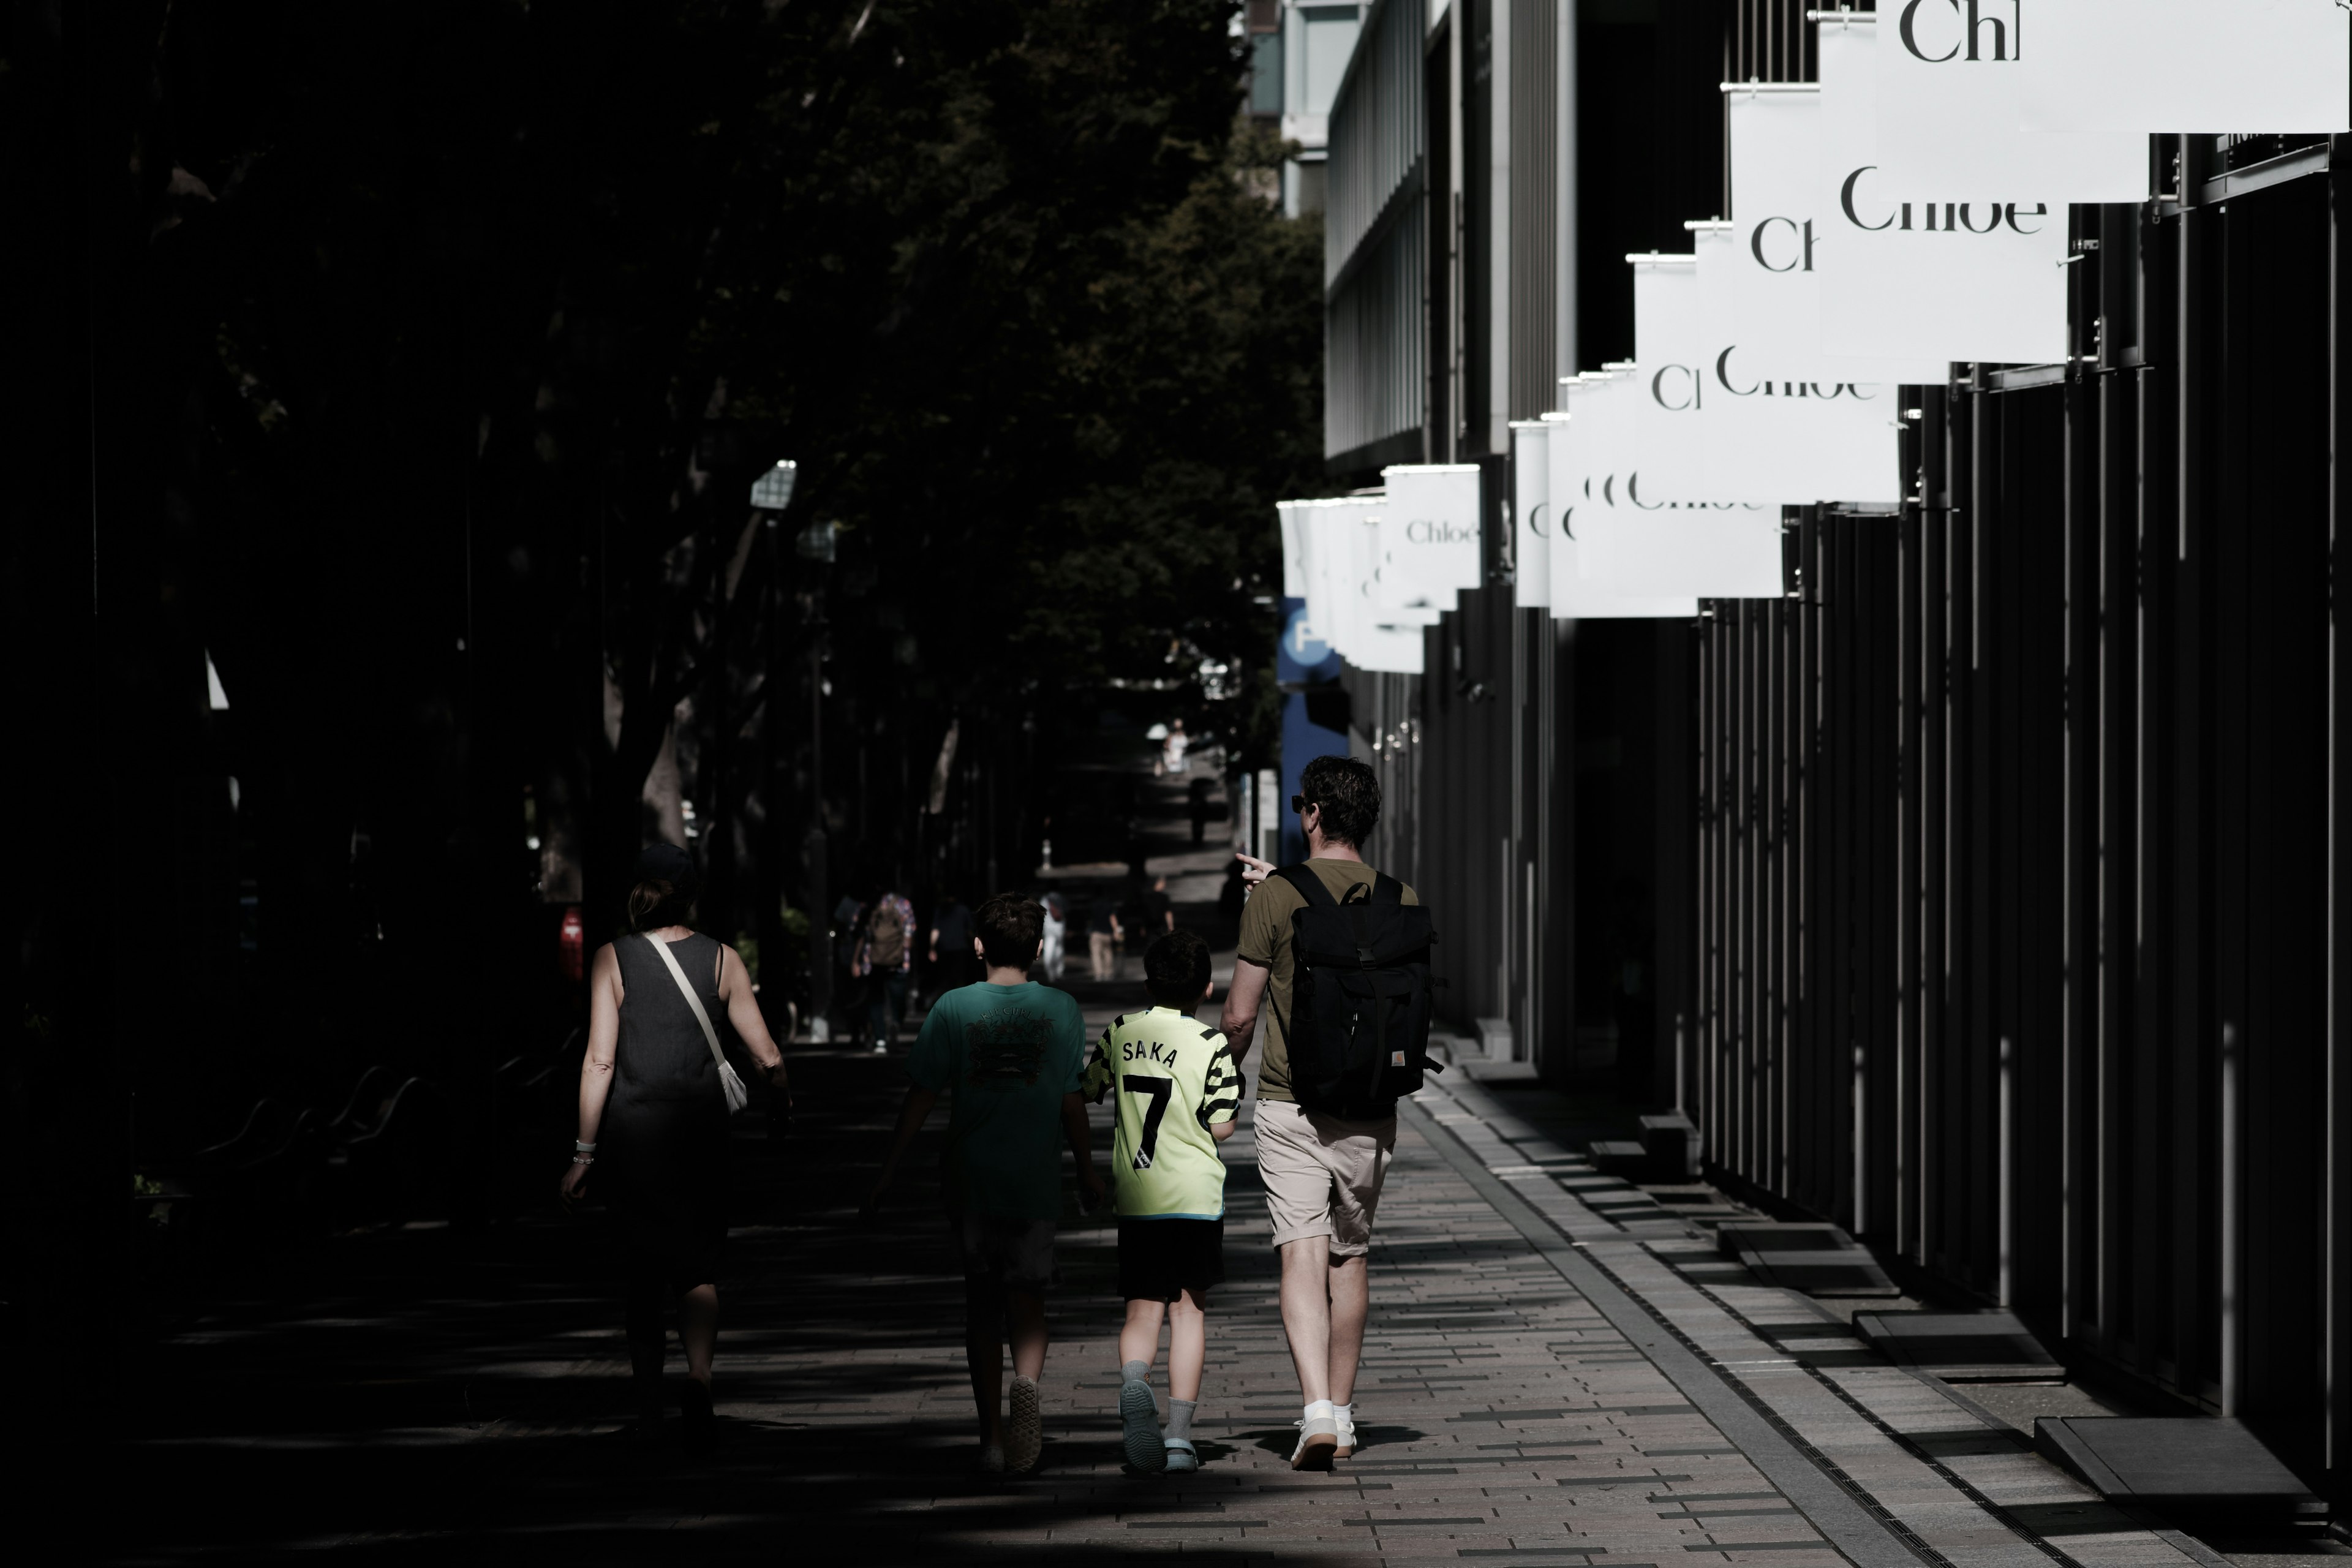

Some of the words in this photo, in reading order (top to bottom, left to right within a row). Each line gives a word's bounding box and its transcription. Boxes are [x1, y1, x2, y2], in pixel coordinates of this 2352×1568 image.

[1003, 1006, 1034, 1021] CURL
[1123, 1040, 1177, 1068] SAKA
[1123, 1074, 1172, 1170] 7
